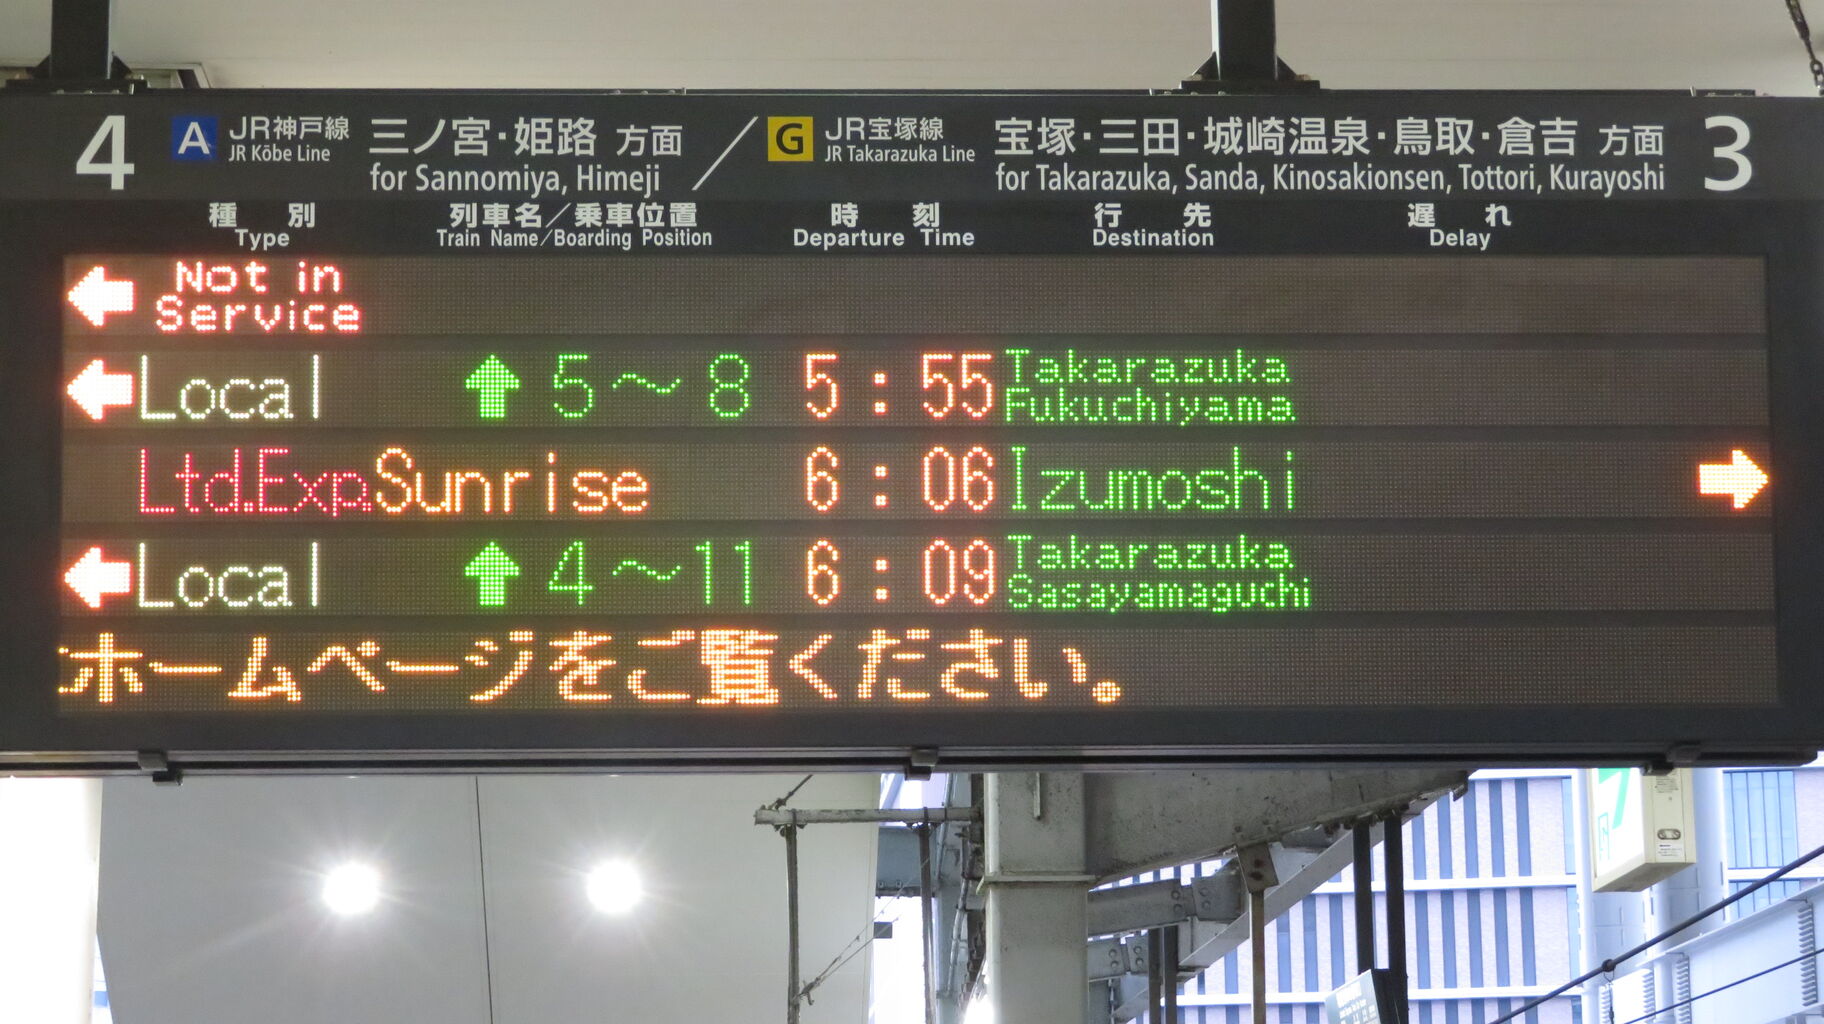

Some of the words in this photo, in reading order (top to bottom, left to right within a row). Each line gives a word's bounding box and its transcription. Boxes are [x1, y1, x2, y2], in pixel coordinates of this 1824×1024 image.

[177, 124, 211, 155] A
[229, 115, 350, 141] JR神戸線
[616, 124, 683, 157] 方面
[776, 122, 804, 155] G
[825, 116, 944, 141] JR宝塚線
[1598, 124, 1664, 156] 方面
[75, 115, 135, 191] 4
[228, 144, 246, 162] JR
[251, 143, 293, 162] Kōbe
[297, 144, 331, 162] Line
[824, 144, 843, 162] JR
[846, 144, 938, 163] Takarazuka
[942, 144, 976, 163] Line
[1704, 115, 1753, 192] 3
[369, 162, 408, 191] for
[415, 164, 568, 199] Sannomiya,
[577, 163, 660, 199] Himeji
[995, 163, 1030, 191] for
[1036, 163, 1178, 195] Takarazuka,
[1185, 162, 1265, 195] Sanda,
[1273, 162, 1452, 195] Kinosakionsen,
[1457, 163, 1543, 195] Tottori,
[1550, 162, 1665, 198] Kurayoshi
[234, 228, 290, 252] Type
[436, 228, 480, 247] Train
[642, 228, 712, 247] Position
[793, 228, 905, 251] Departure
[919, 228, 975, 247] Time
[1092, 228, 1214, 248] Destination
[1429, 228, 1491, 251] Delay
[175, 260, 268, 294] Not
[298, 260, 341, 294] in
[156, 295, 361, 332] Service
[1005, 349, 1291, 384] Takarazuka
[140, 354, 320, 420] Local
[1005, 387, 1296, 426] Fukuchiyama
[376, 447, 650, 515] Sunrise
[1011, 446, 1293, 511] Izumoshi
[1007, 534, 1295, 570] Takarazuka
[138, 542, 319, 608] Local
[1007, 573, 1310, 613] Sasayamaguchi
[58, 629, 1122, 706] ホームページをご覧ください。
